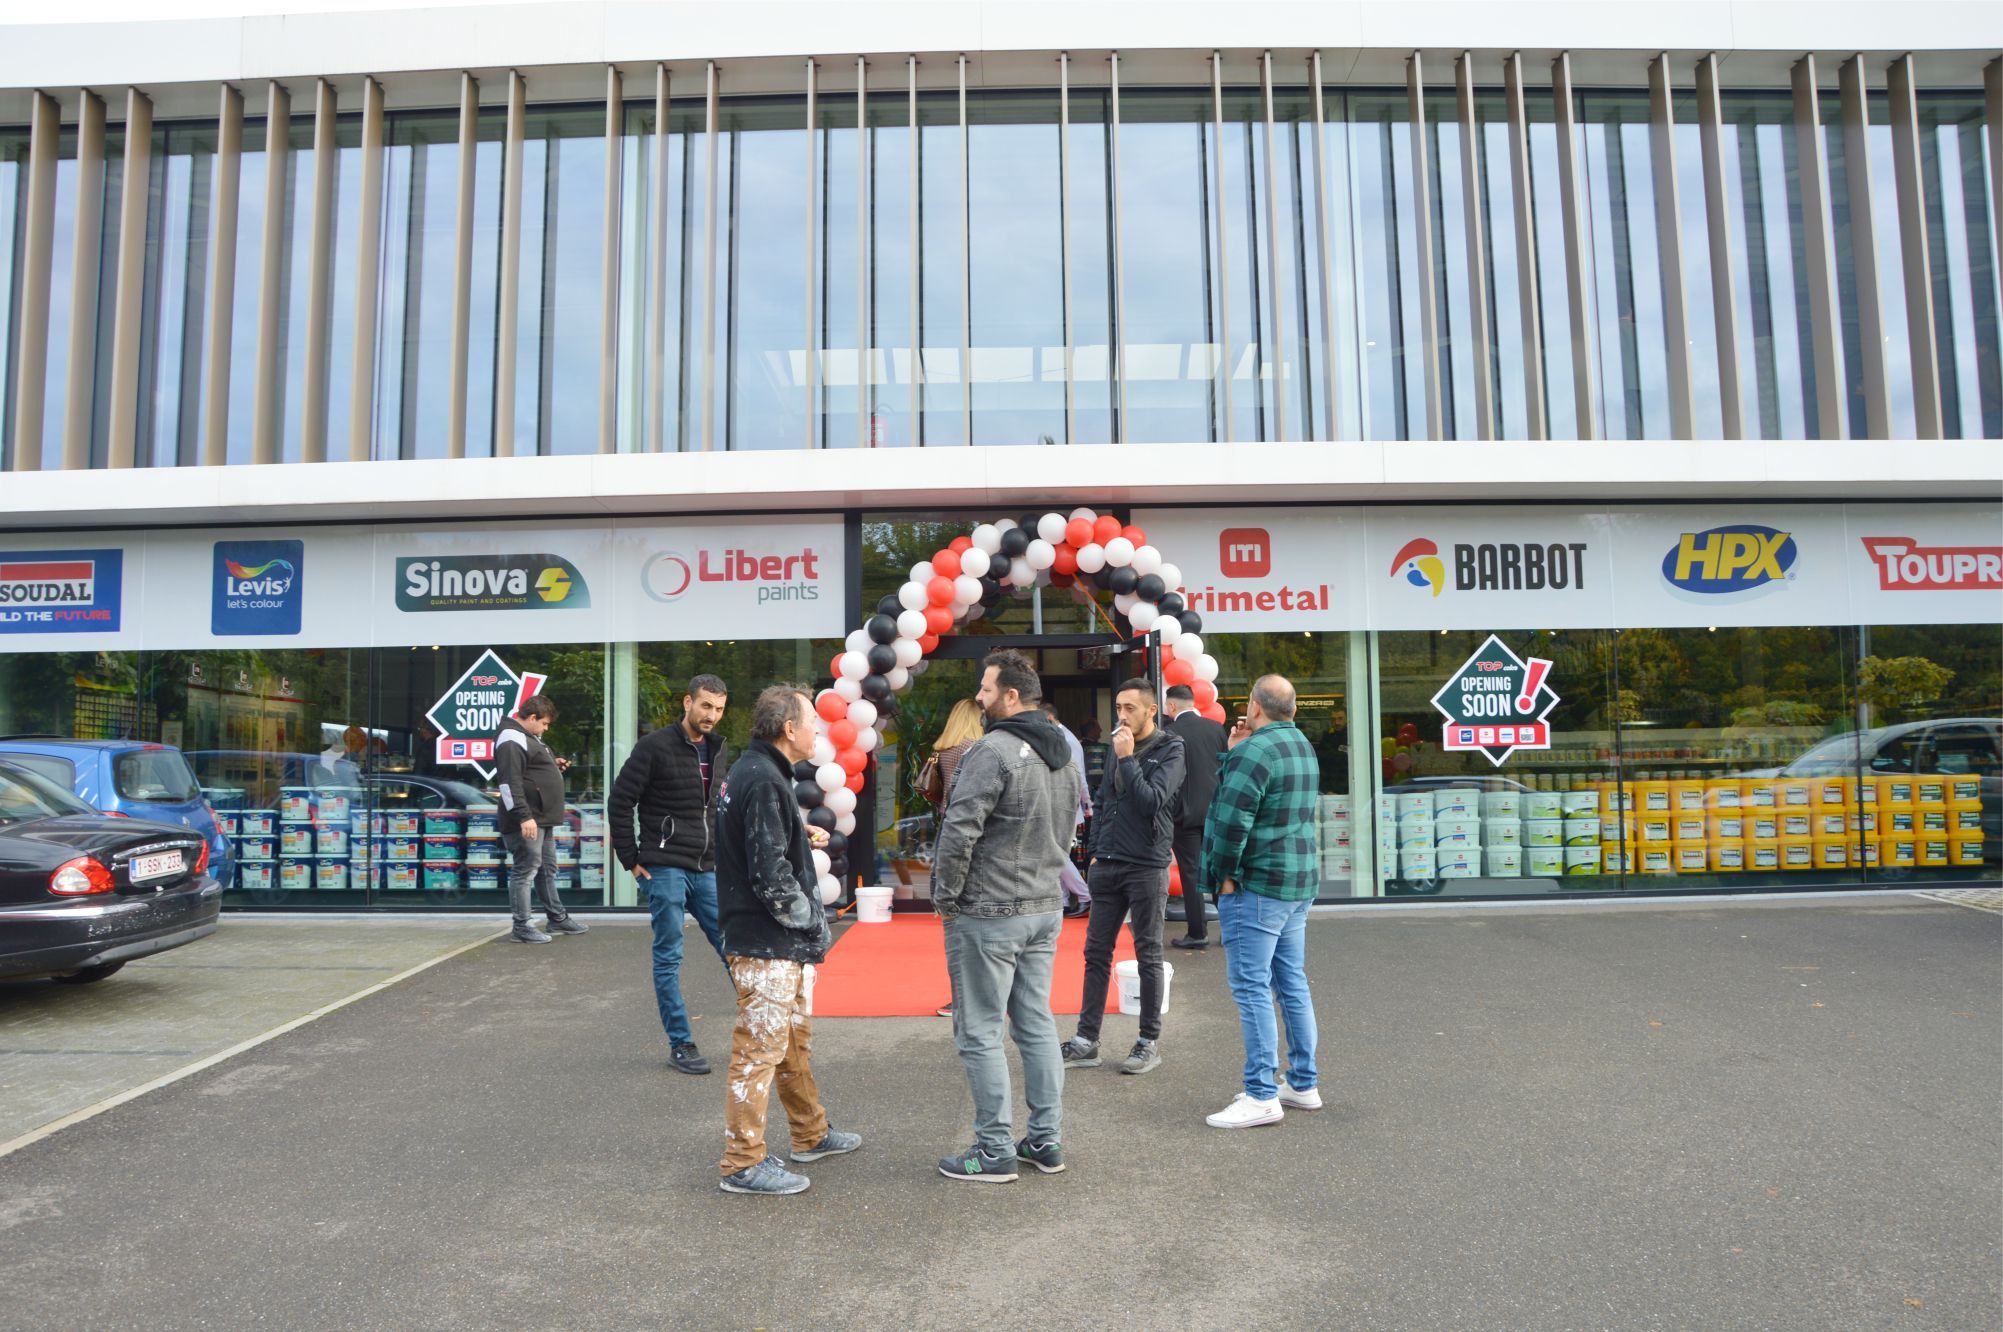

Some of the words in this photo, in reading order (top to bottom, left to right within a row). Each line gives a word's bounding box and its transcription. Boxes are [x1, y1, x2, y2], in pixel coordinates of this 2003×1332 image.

[699, 548, 818, 581] Libert
[1674, 533, 1791, 579] HPX
[1454, 543, 1587, 590] BARBOT
[227, 577, 284, 596] Levis
[406, 561, 527, 597] Sinova
[0, 583, 91, 602] SOUDAL
[758, 582, 818, 605] paints
[1176, 585, 1329, 612] rimetal
[227, 599, 248, 609] let's
[249, 600, 284, 608] colour
[24, 611, 53, 621] THE
[54, 610, 111, 621] FUTURE
[1475, 661, 1504, 672] TOP
[471, 675, 498, 686] TOP
[1461, 677, 1512, 692] OPENING
[455, 691, 505, 706] OPENING
[1462, 694, 1512, 717] SOON
